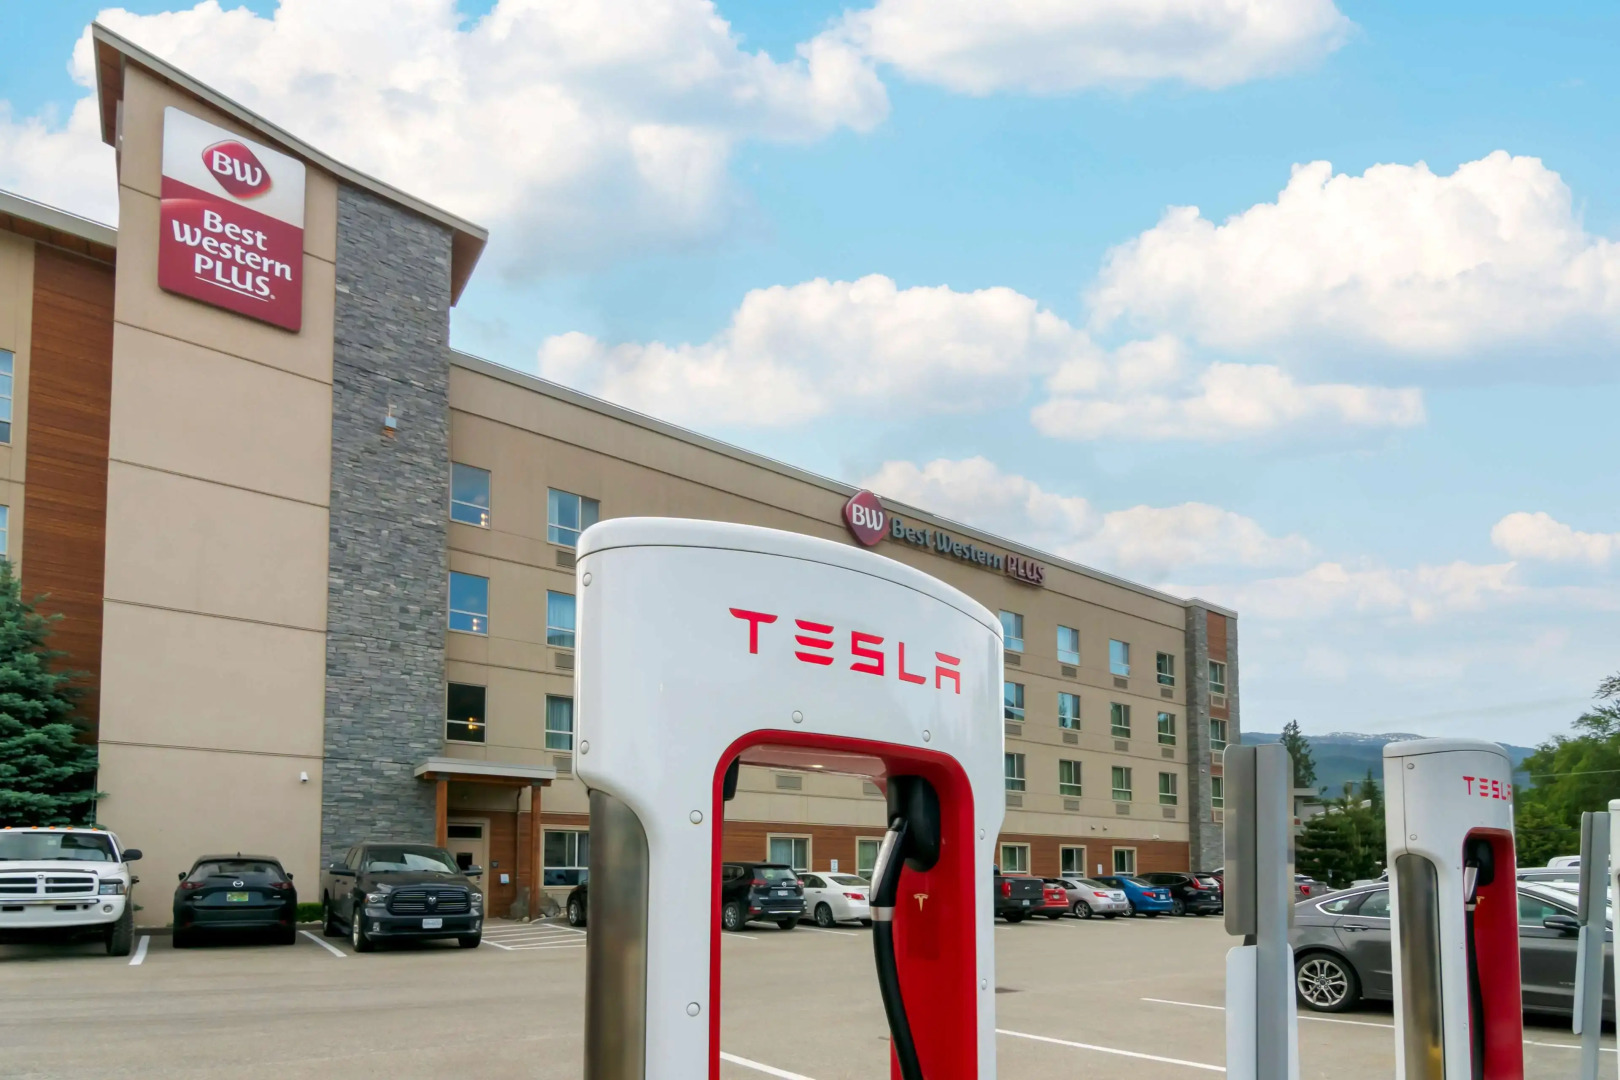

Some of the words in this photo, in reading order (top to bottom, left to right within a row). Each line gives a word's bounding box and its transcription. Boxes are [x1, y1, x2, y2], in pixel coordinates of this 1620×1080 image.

[212, 150, 262, 187] BW
[171, 219, 293, 281] Western
[203, 209, 268, 251] Best
[852, 503, 884, 531] BW
[891, 517, 931, 546] Best
[934, 530, 1004, 570] Western
[728, 607, 961, 695] TESLA
